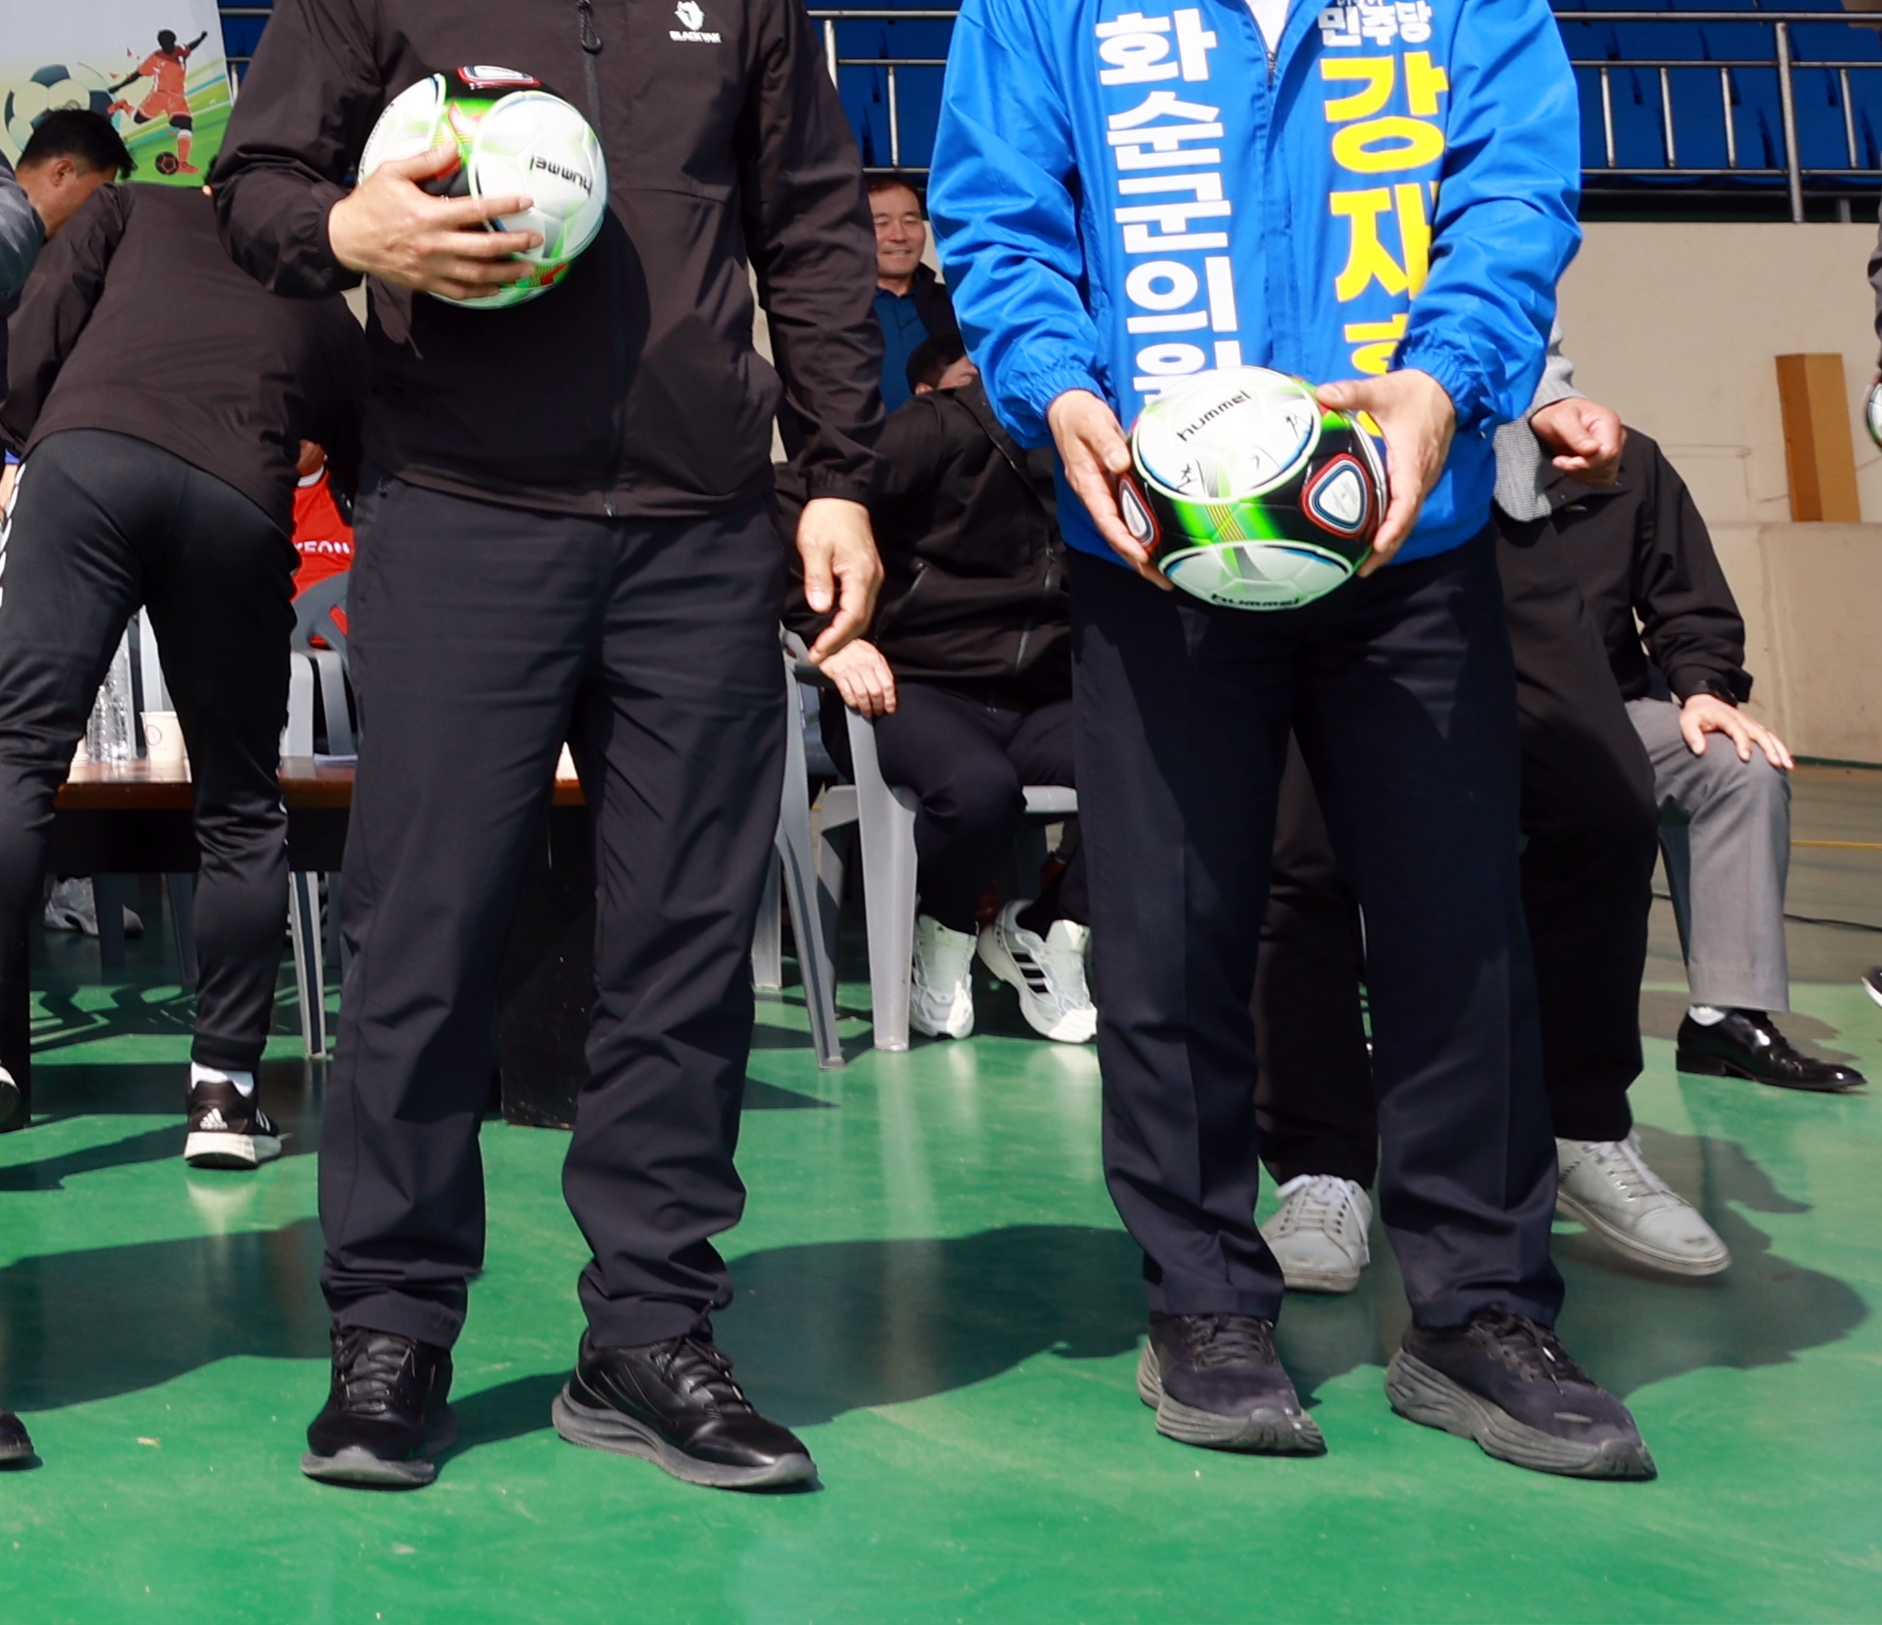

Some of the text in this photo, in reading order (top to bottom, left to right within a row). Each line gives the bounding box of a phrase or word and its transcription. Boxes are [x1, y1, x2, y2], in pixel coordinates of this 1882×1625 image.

[1318, 0, 1433, 47] 민주당
[529, 154, 594, 198] hummel
[1175, 389, 1252, 443] hummel
